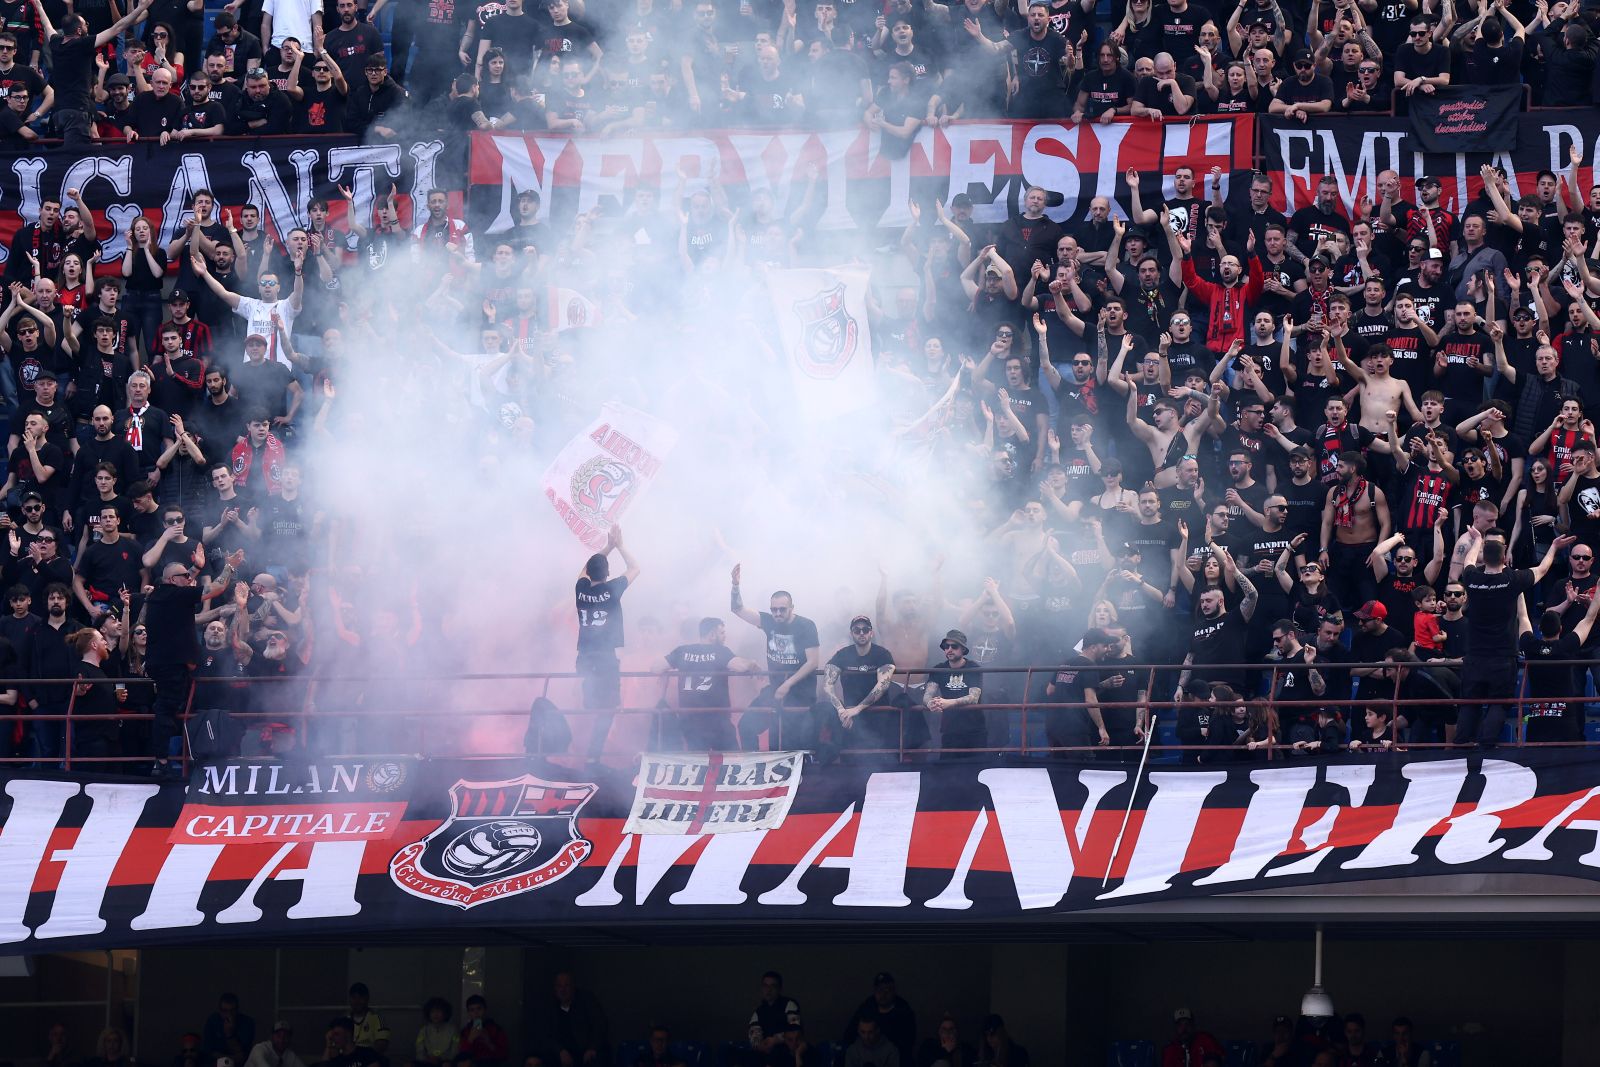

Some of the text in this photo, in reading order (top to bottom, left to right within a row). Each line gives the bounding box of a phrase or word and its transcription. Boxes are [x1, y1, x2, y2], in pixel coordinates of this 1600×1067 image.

[1439, 100, 1487, 115] quattordici
[1447, 109, 1475, 122] ottobre
[1434, 121, 1488, 133] duemiladieci
[1541, 123, 1600, 212] R
[0, 139, 438, 264] IGANTI
[1403, 351, 1418, 359] SUD
[1553, 445, 1572, 453] Emir
[1416, 490, 1443, 502] Emirates
[198, 764, 364, 796] MILAN
[646, 756, 796, 788] ULTRAS
[638, 800, 776, 824] LIBERI
[185, 811, 391, 838] CAPITALE
[482, 859, 568, 899] Milano
